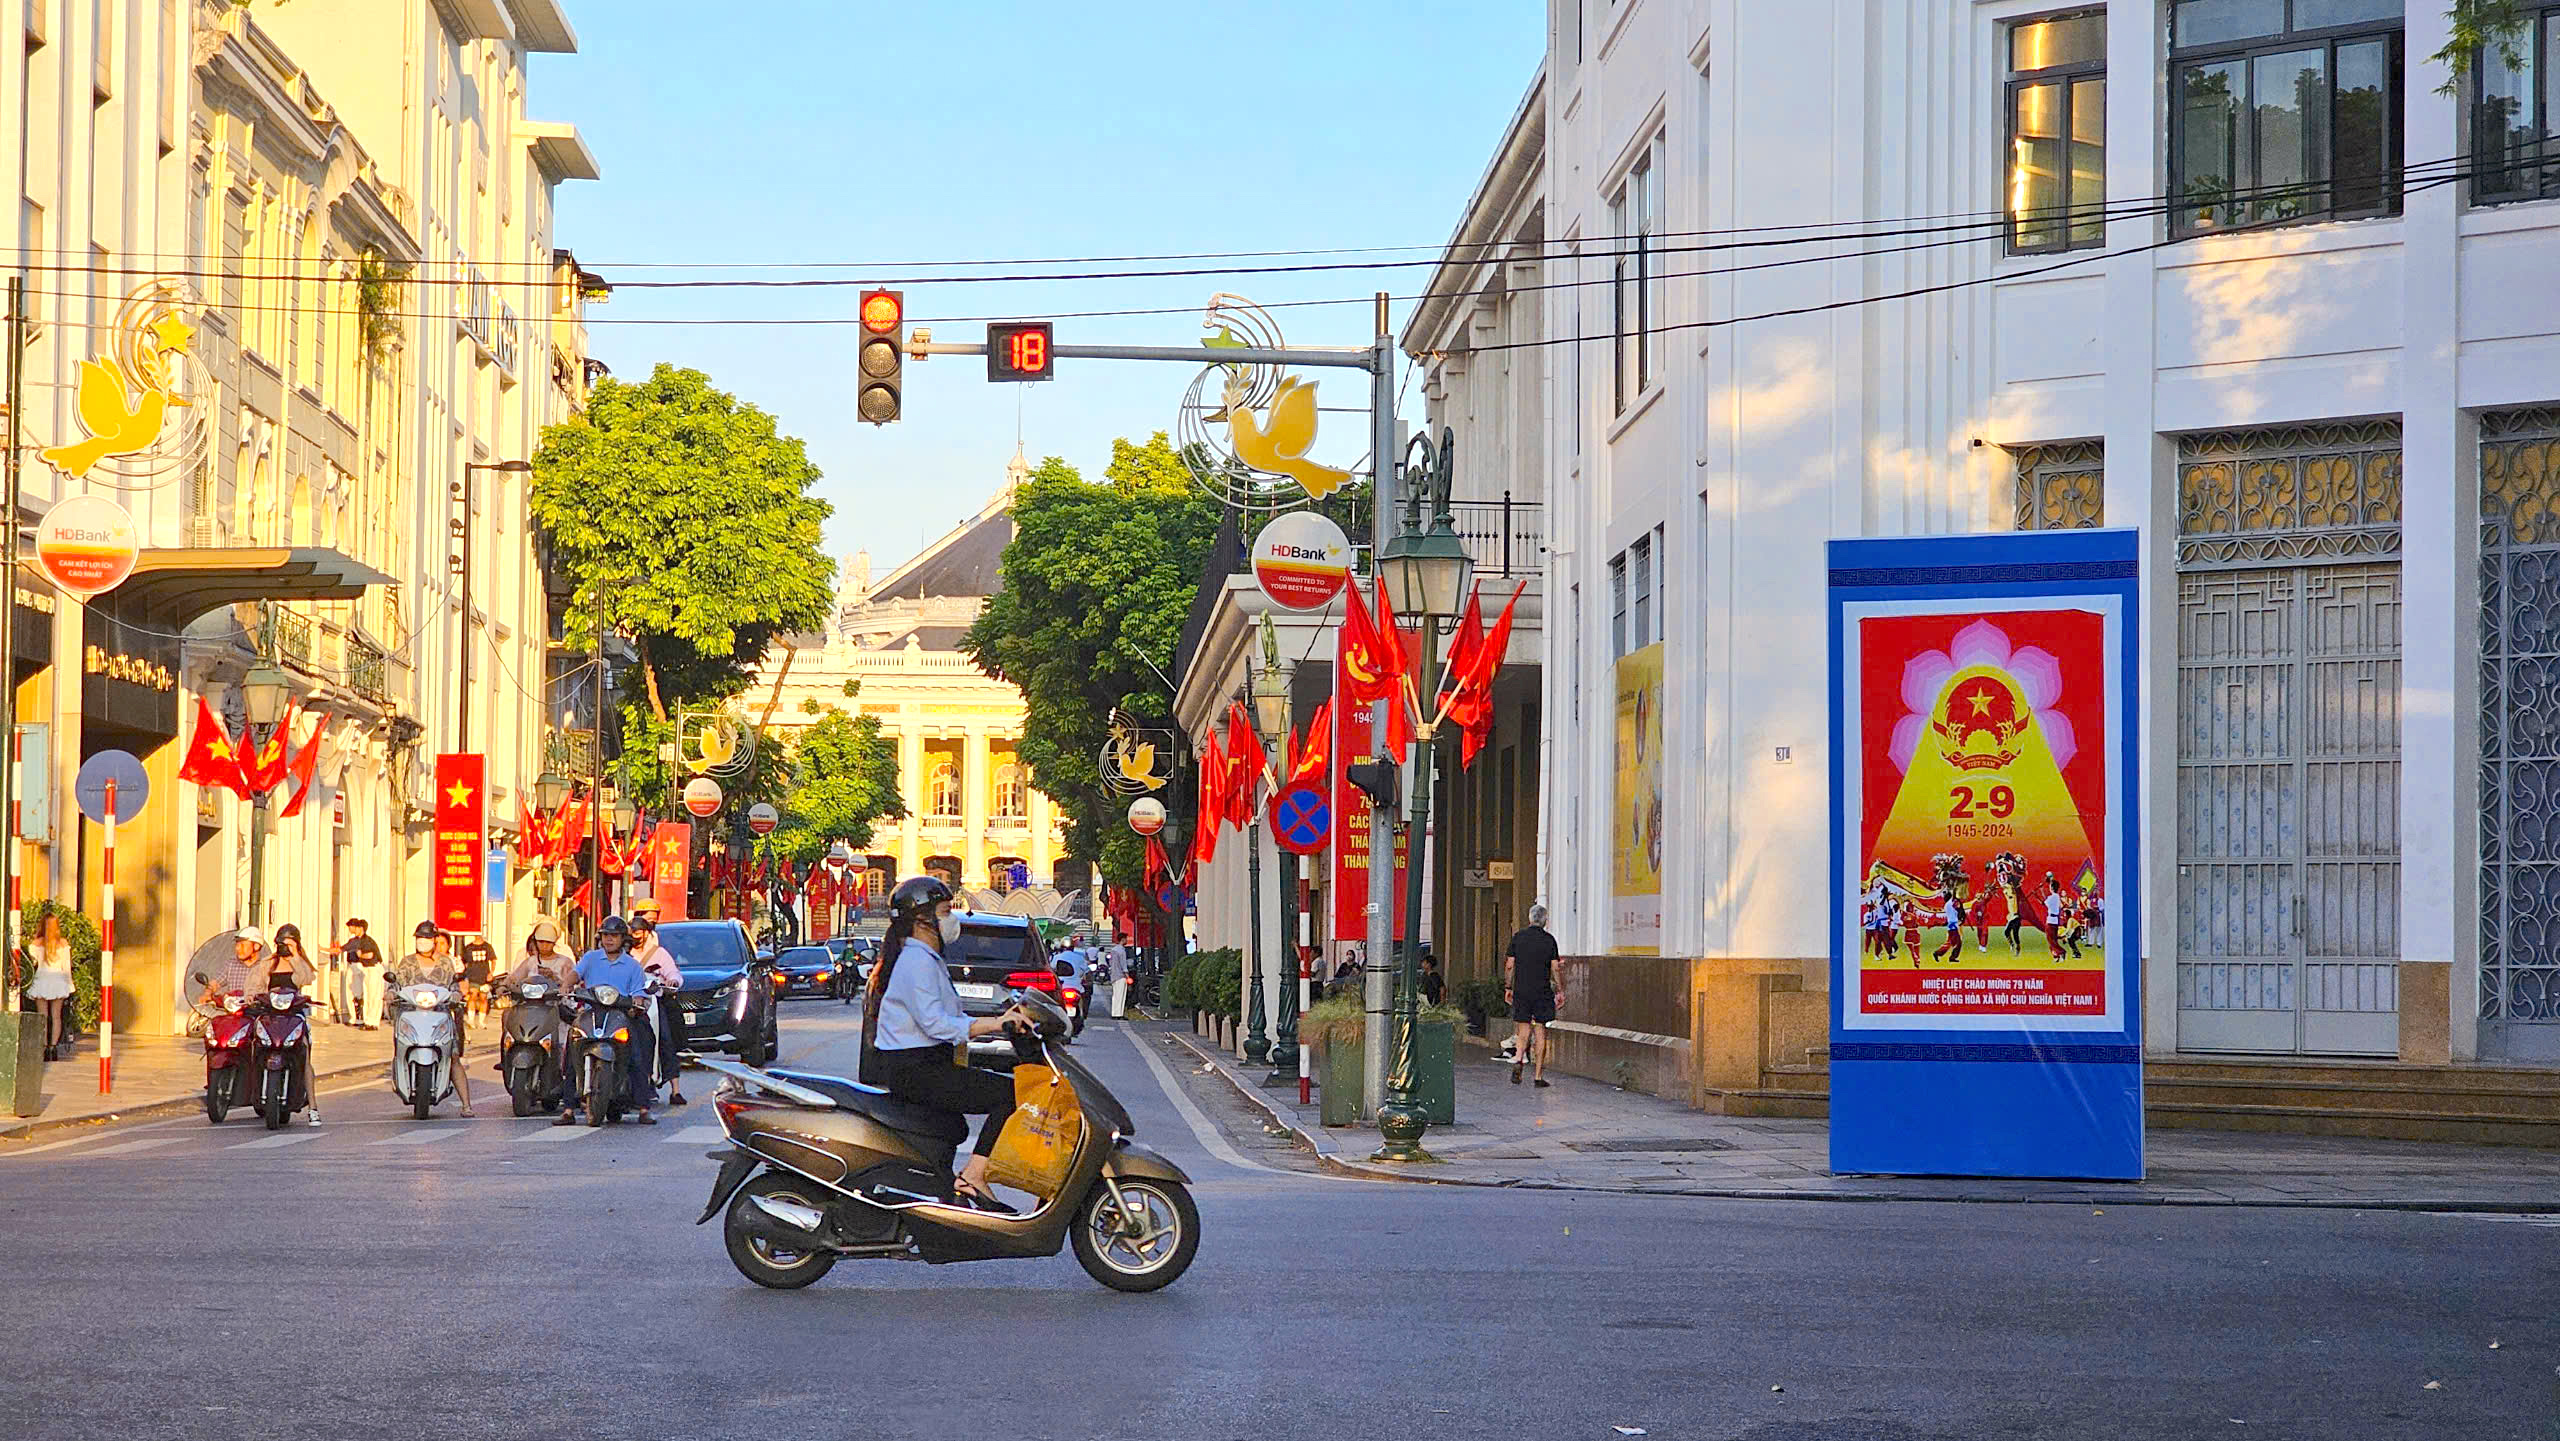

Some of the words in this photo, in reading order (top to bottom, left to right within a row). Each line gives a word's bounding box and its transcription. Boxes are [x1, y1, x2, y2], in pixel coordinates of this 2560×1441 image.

[1012, 331, 1046, 372] 18
[55, 528, 111, 542] HDBank
[1271, 544, 1326, 561] HDBank
[1279, 575, 1316, 585] COMMITTED
[1271, 583, 1287, 591] YOUR
[1288, 584, 1303, 592] BEST
[1304, 586, 1332, 595] RETURNS
[1950, 785, 2015, 819] 2-9
[1349, 815, 1369, 829] CÁC
[1947, 823, 2013, 838] 1945-2024
[1350, 832, 1369, 849] THÁ
[1344, 852, 1369, 869] THÀN
[660, 861, 683, 878] 2-9
[1922, 978, 1945, 991] NHIỆT
[1946, 978, 1962, 991] LIỆT
[1964, 978, 1985, 990] CHÀO
[1987, 977, 2011, 990] MỪNG
[2013, 980, 2023, 990] 79
[2024, 978, 2044, 990] NĂM
[1868, 991, 1888, 1005] QUỐC
[1890, 992, 1917, 1004] KHÁNH
[1918, 991, 1940, 1004] NƯỚC
[1941, 992, 1963, 1006] CỘNG
[1965, 992, 1981, 1004] HÒA
[1982, 992, 1993, 1004] XÃ
[1995, 992, 2009, 1007] HỘI
[2010, 990, 2027, 1005] CHỦ
[2028, 993, 2052, 1005] NGHĨA
[2054, 992, 2072, 1007] VIỆT
[2073, 994, 2093, 1005] NAM
